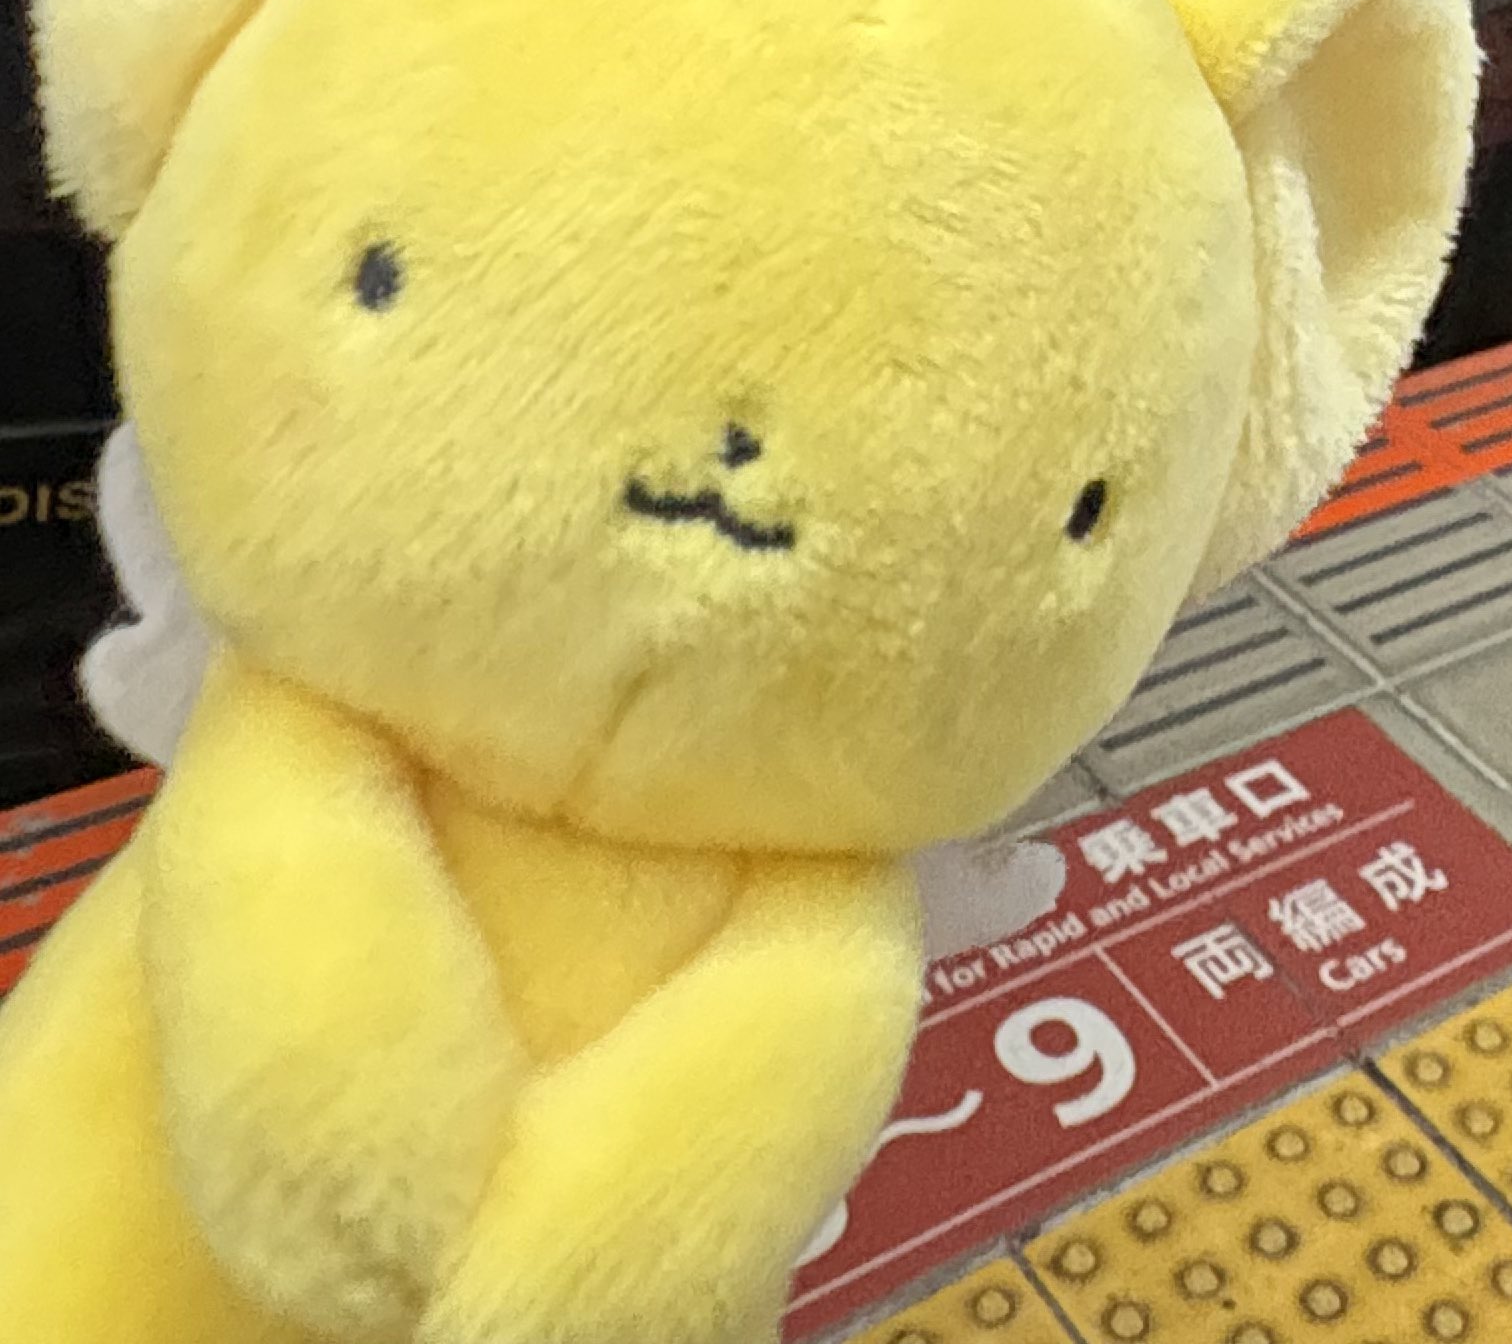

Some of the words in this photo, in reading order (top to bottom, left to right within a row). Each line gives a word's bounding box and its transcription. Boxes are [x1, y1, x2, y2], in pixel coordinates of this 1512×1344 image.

[1076, 758, 1311, 884] 乗車口
[934, 957, 988, 996] for
[988, 910, 1087, 974] Rapid
[1091, 884, 1151, 930] and
[1147, 847, 1231, 901] Local
[1227, 800, 1346, 864] Services
[1170, 840, 1450, 1000] 両編成
[1317, 936, 1409, 992] Cars
